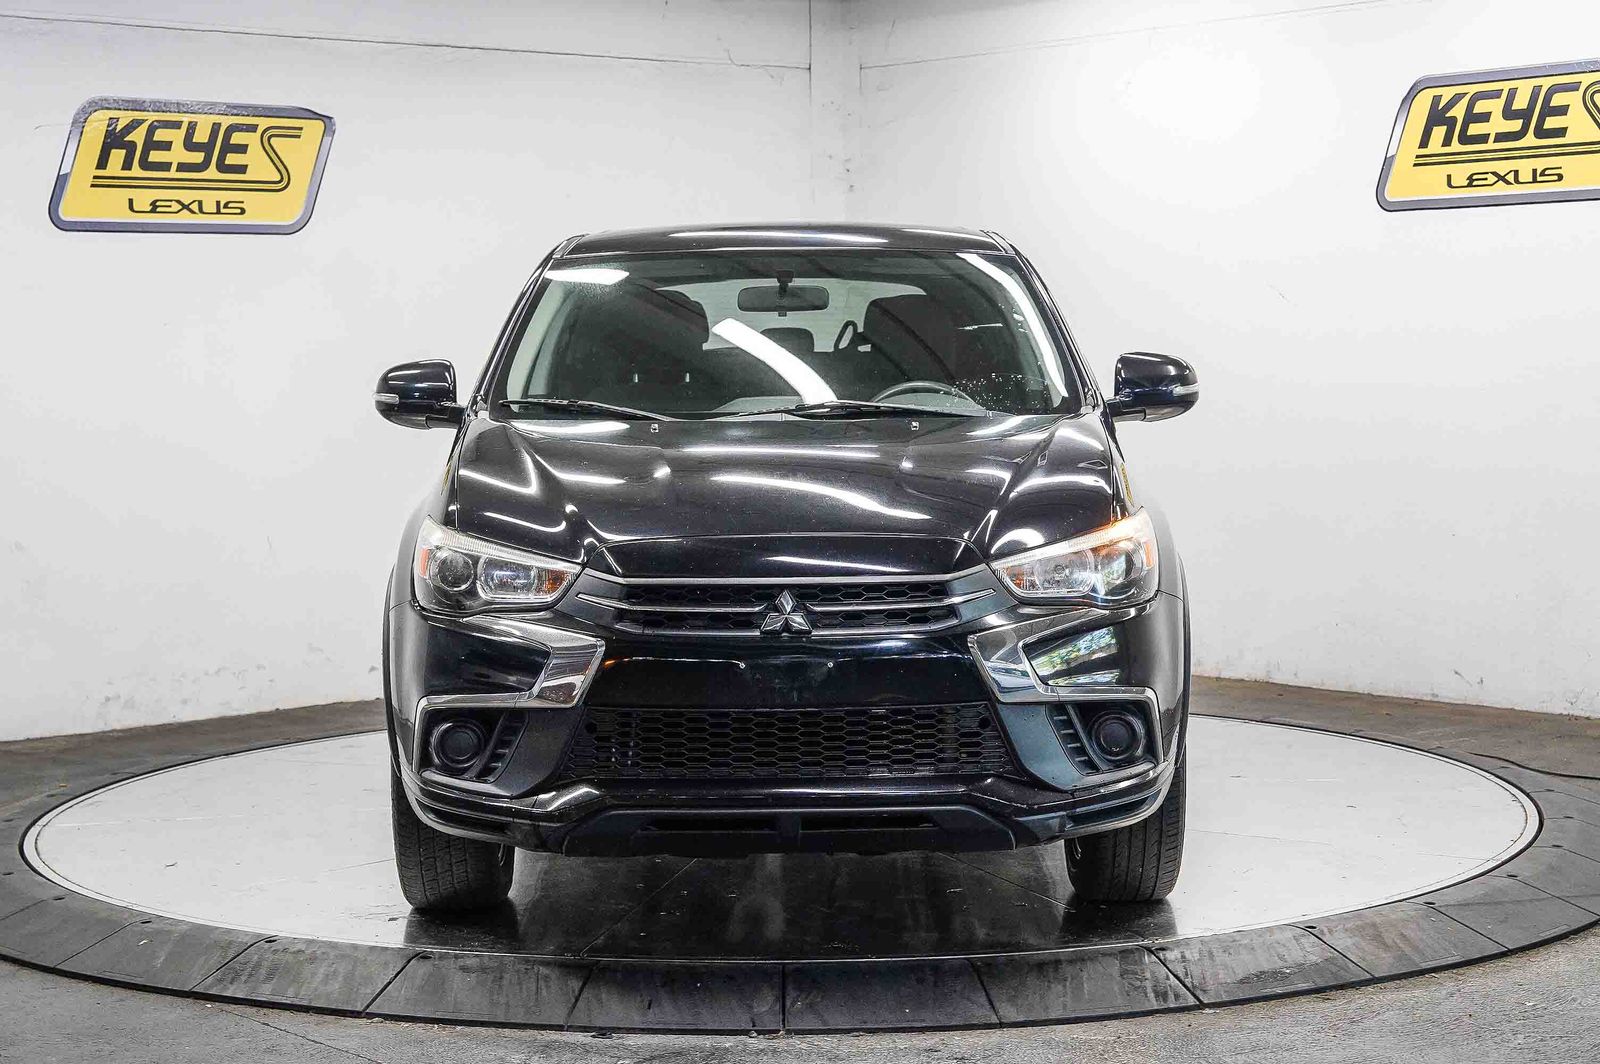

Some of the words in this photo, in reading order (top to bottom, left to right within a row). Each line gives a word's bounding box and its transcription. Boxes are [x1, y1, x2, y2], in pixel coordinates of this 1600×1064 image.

[93, 117, 303, 189] KEYES
[1446, 166, 1564, 189] LEXUS
[127, 197, 246, 216] LEXUS
